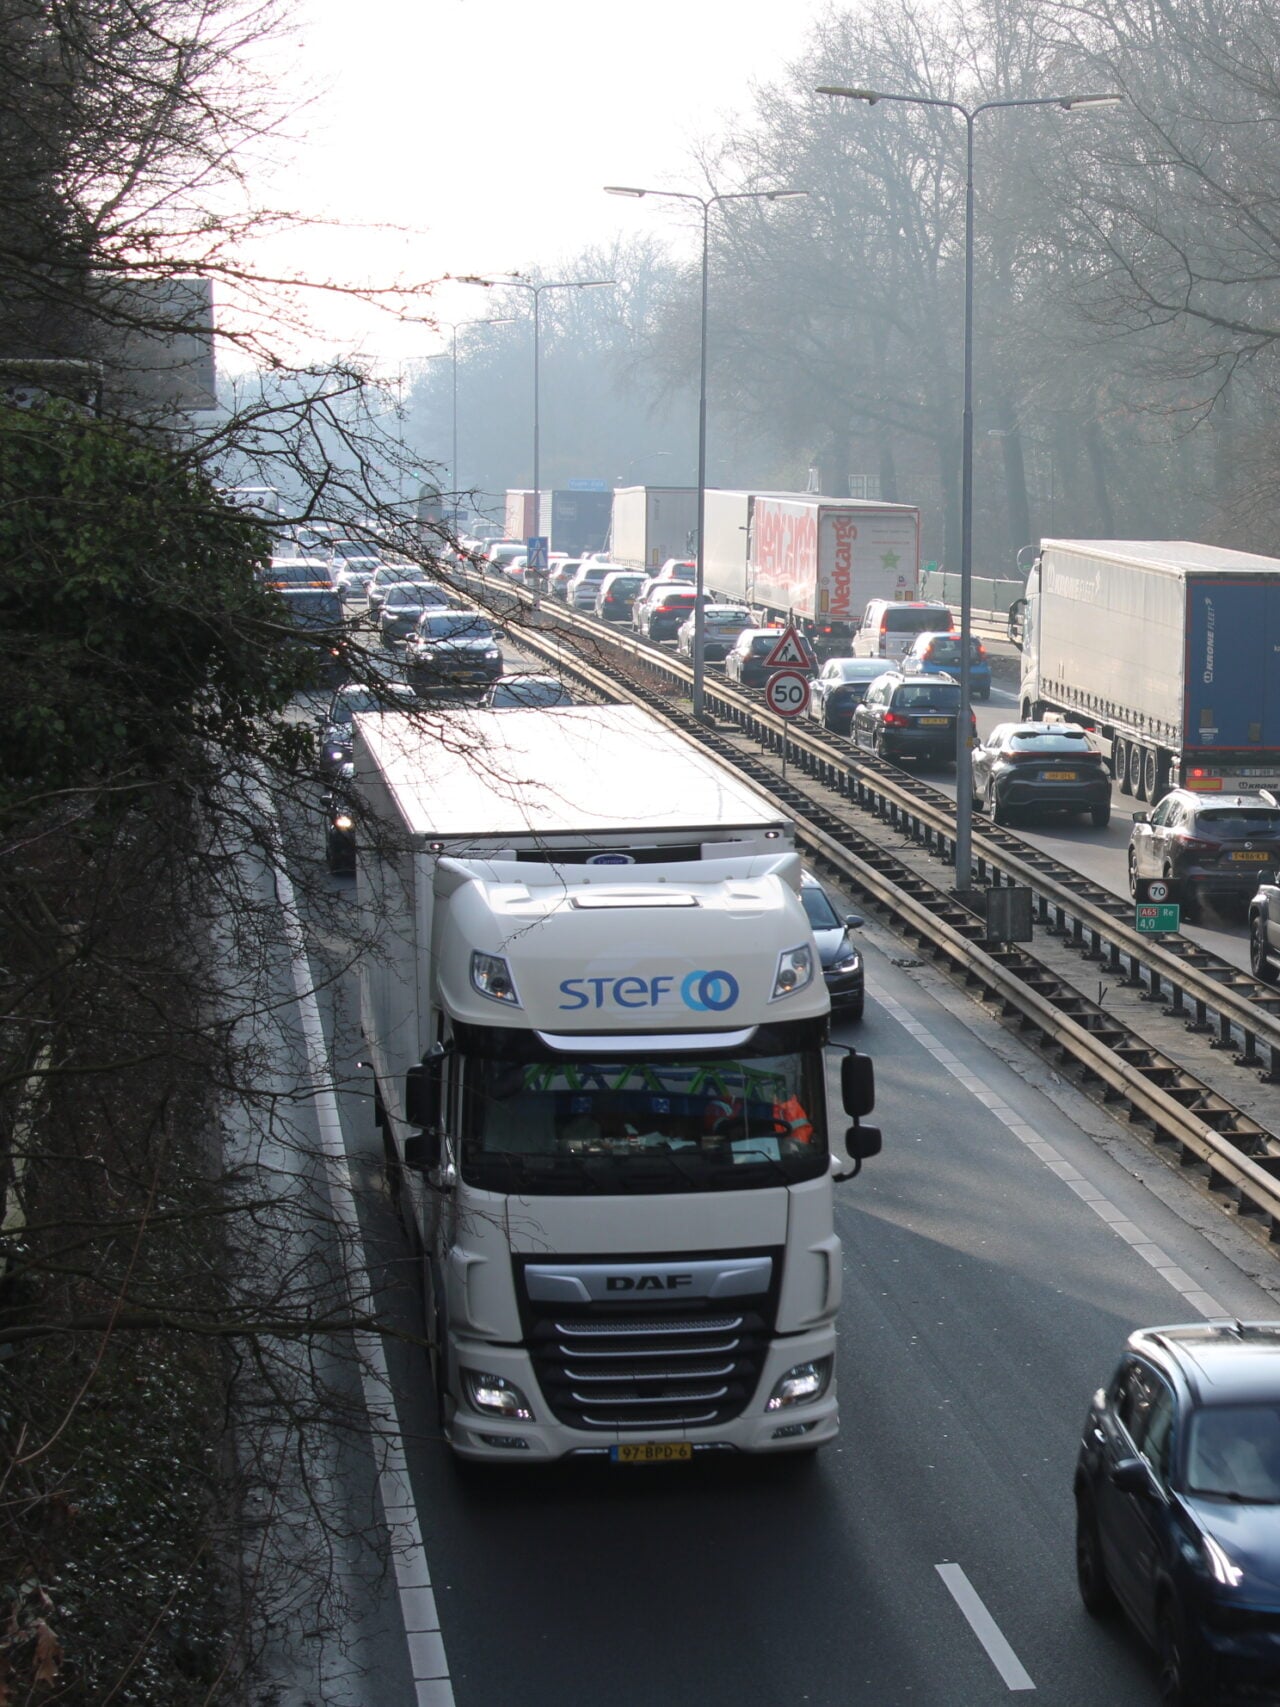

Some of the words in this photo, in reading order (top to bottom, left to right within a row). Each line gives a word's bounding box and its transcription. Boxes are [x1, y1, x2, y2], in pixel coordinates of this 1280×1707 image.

[830, 516, 857, 615] Nedcargo
[1207, 606, 1215, 630] FLEET
[1206, 630, 1215, 670] KRONE
[774, 685, 803, 704] 50
[1248, 782, 1279, 790] KRONE
[1151, 886, 1166, 897] 70
[1141, 908, 1157, 916] A65
[1163, 908, 1174, 917] Re
[606, 1274, 693, 1291] DAF
[622, 1444, 688, 1459] 97-BPD-6
